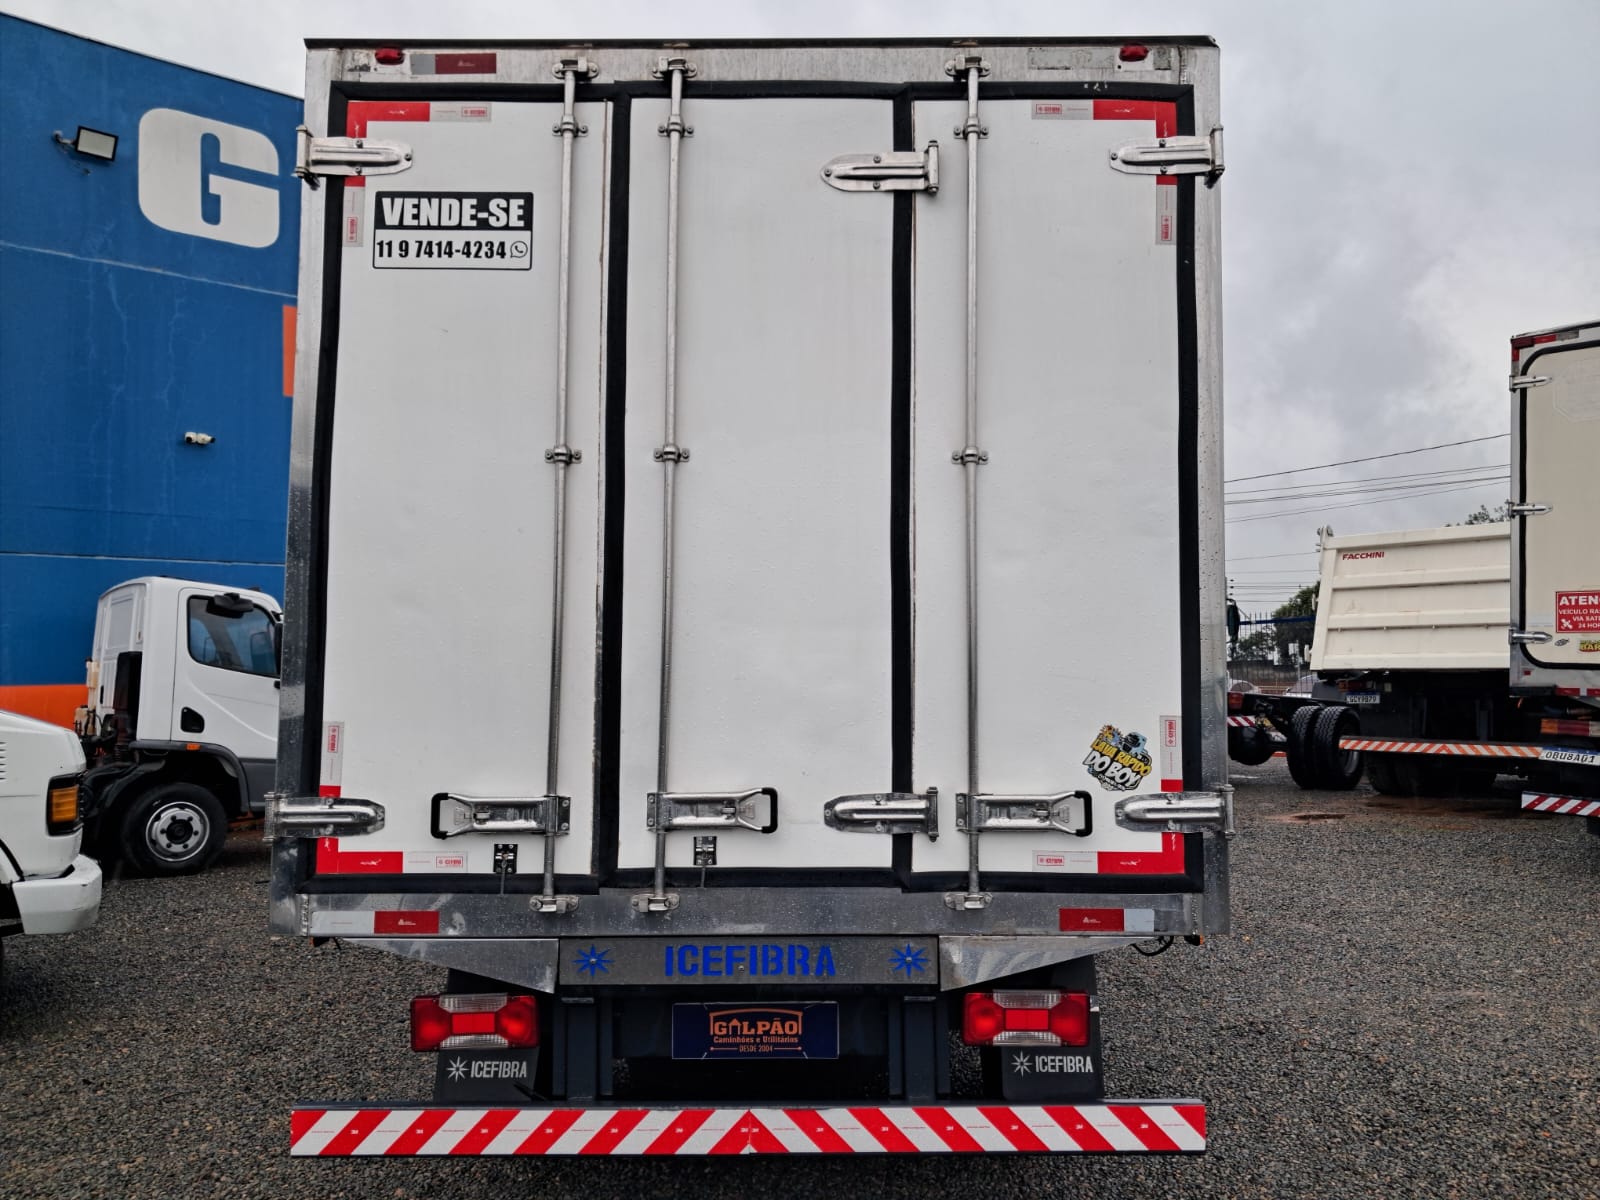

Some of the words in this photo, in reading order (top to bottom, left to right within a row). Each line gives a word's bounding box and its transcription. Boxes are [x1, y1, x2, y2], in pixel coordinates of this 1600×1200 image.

[138, 107, 279, 248] G
[382, 197, 525, 228] VENDE-SE
[376, 240, 393, 258] 11
[398, 240, 410, 258] 9
[415, 240, 507, 259] 7414-4234
[1342, 551, 1385, 561] FACCHINI
[1560, 595, 1600, 606] ATEN
[1092, 739, 1118, 758] LAVA
[1083, 750, 1111, 772] DO
[1105, 761, 1141, 787] BOY
[665, 944, 836, 977] ICEFIBRA
[470, 1060, 527, 1079] ICEFIBRA
[1035, 1055, 1094, 1073] ICEFIBRA
